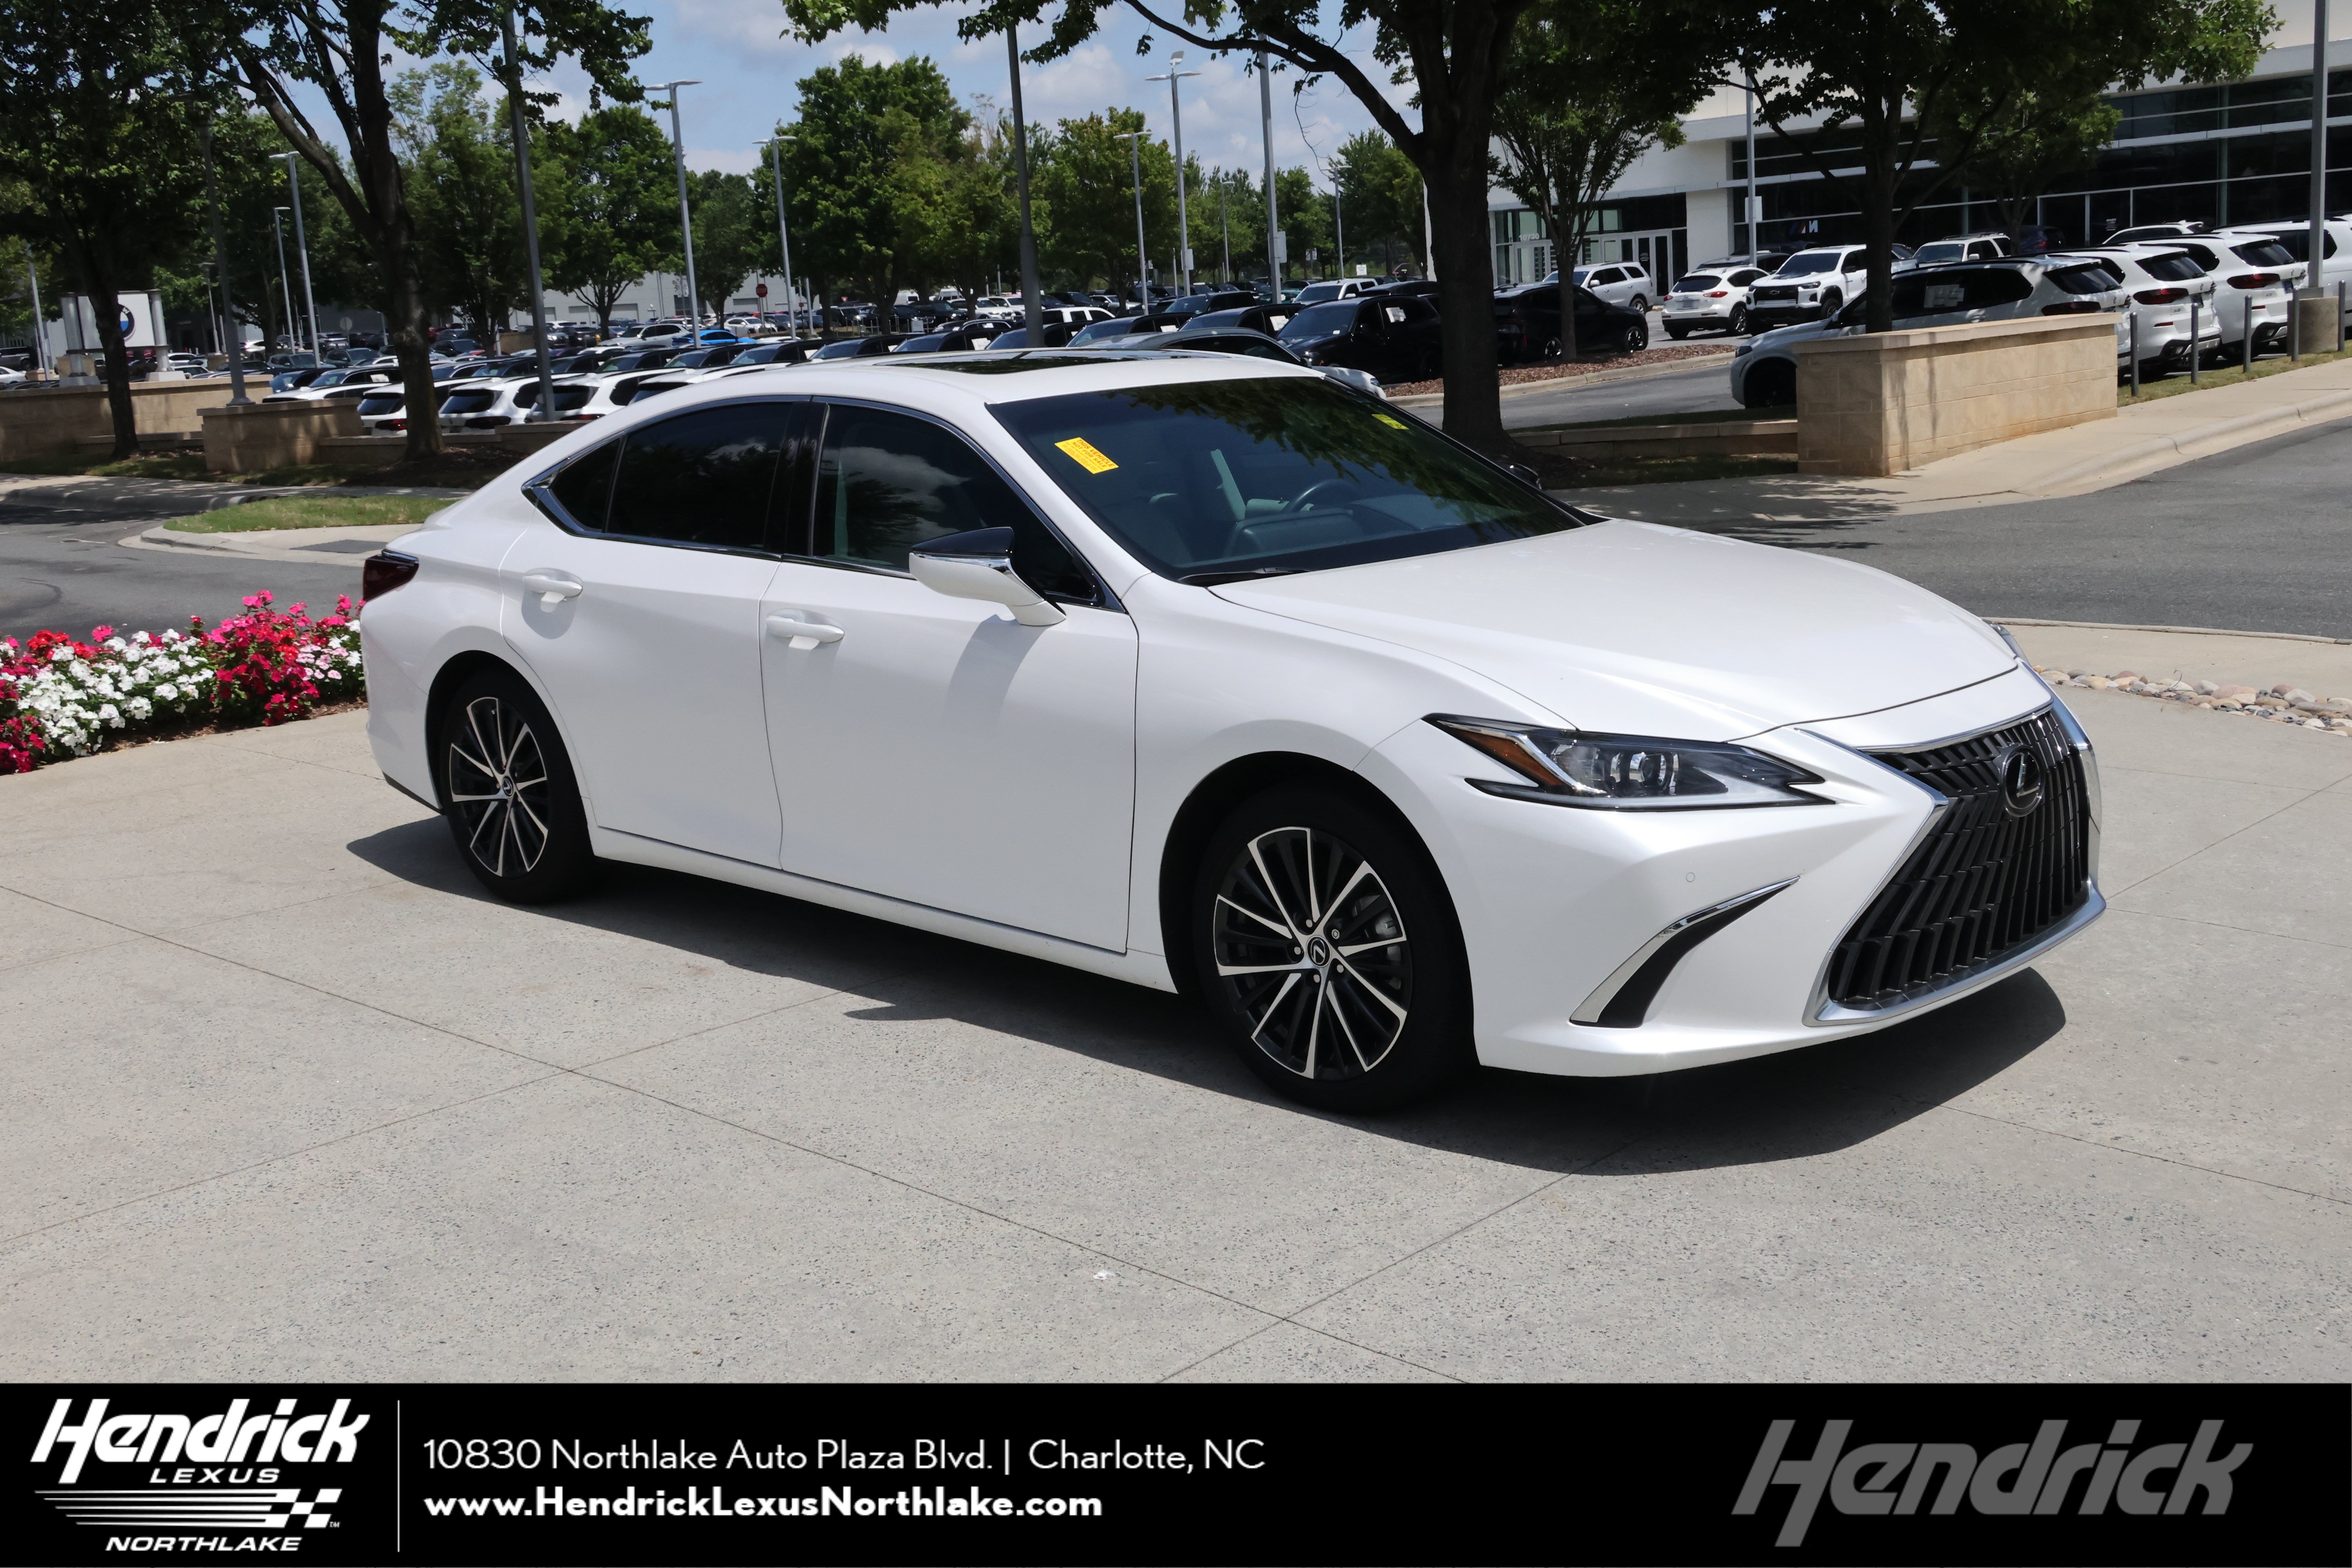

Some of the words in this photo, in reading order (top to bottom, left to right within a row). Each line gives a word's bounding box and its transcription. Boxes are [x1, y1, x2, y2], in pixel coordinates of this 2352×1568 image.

[1519, 233, 1539, 241] 10720
[1076, 439, 1091, 449] THIS
[1090, 449, 1115, 467] VEHICLE
[1082, 450, 1094, 458] FOR
[1093, 458, 1107, 468] SALE
